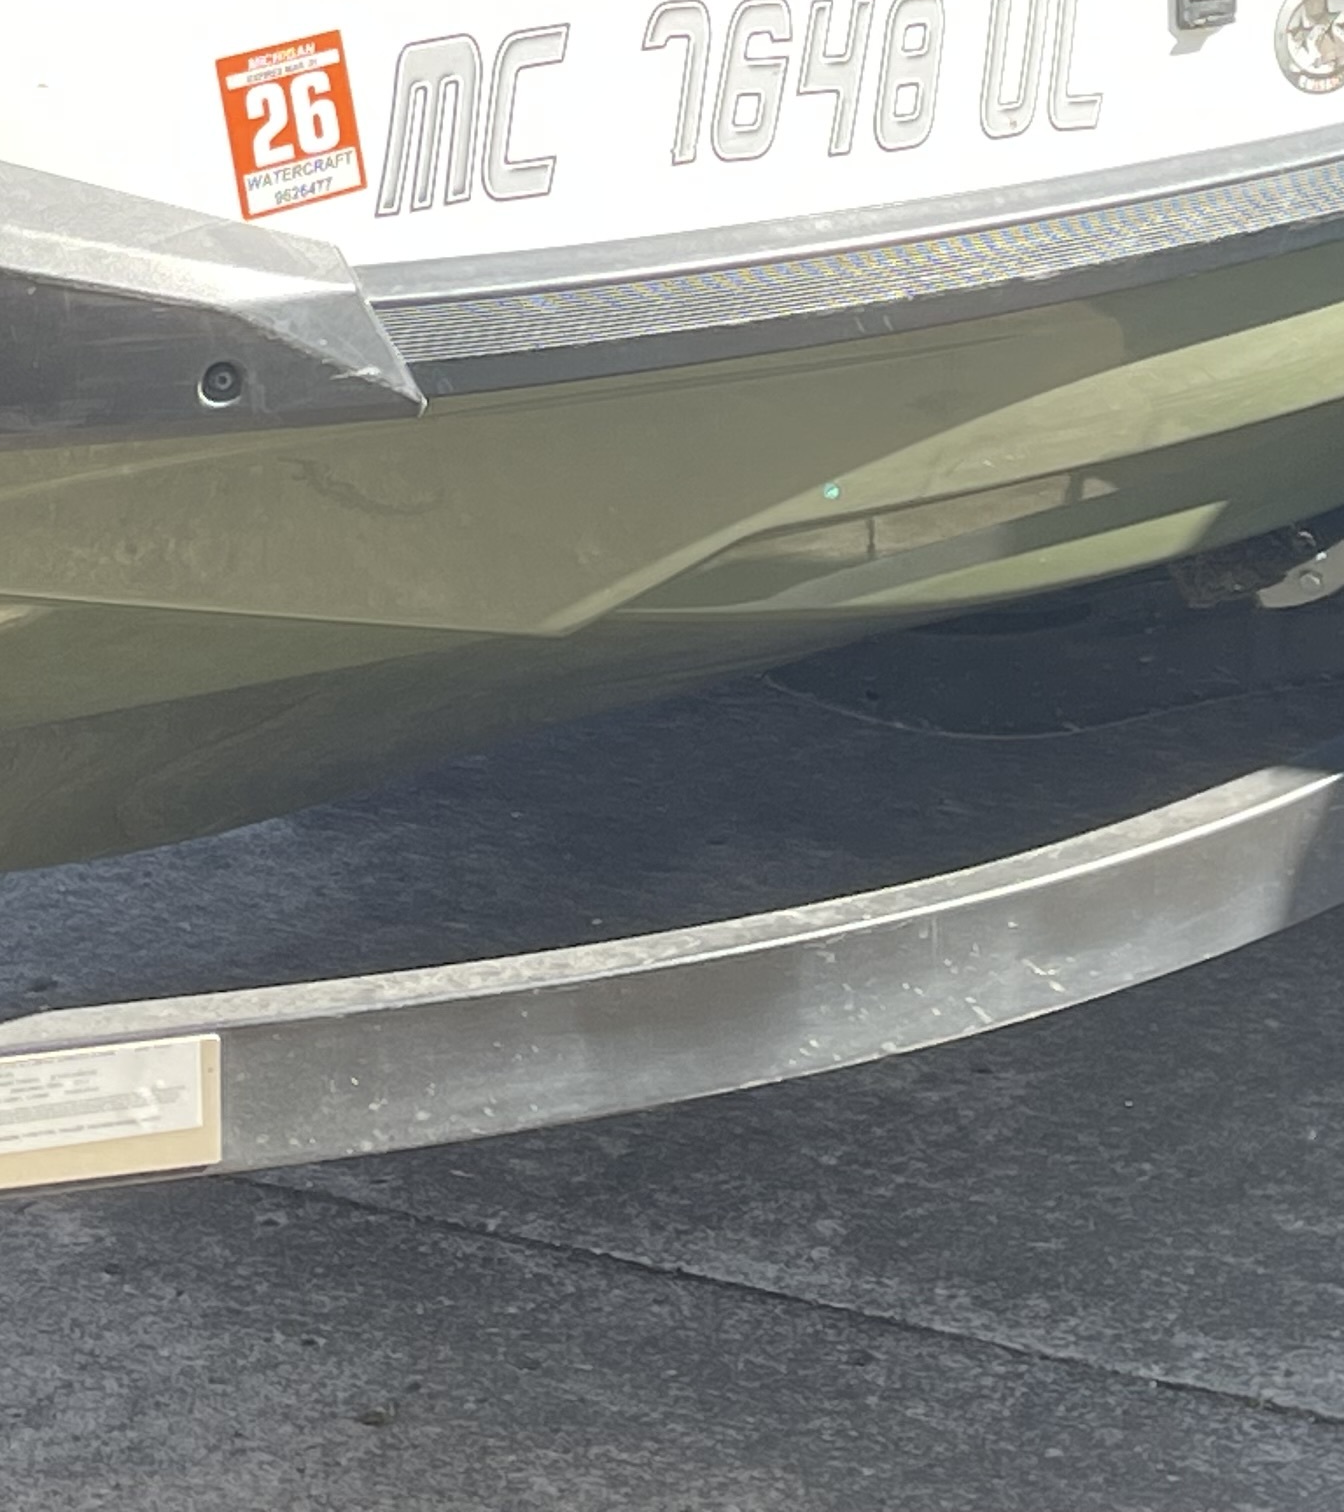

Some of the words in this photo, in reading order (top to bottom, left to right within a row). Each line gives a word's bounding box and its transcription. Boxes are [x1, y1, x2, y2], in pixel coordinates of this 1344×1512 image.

[245, 70, 341, 169] 26
[374, 22, 570, 218] MC
[246, 149, 354, 191] WATERCRAFT
